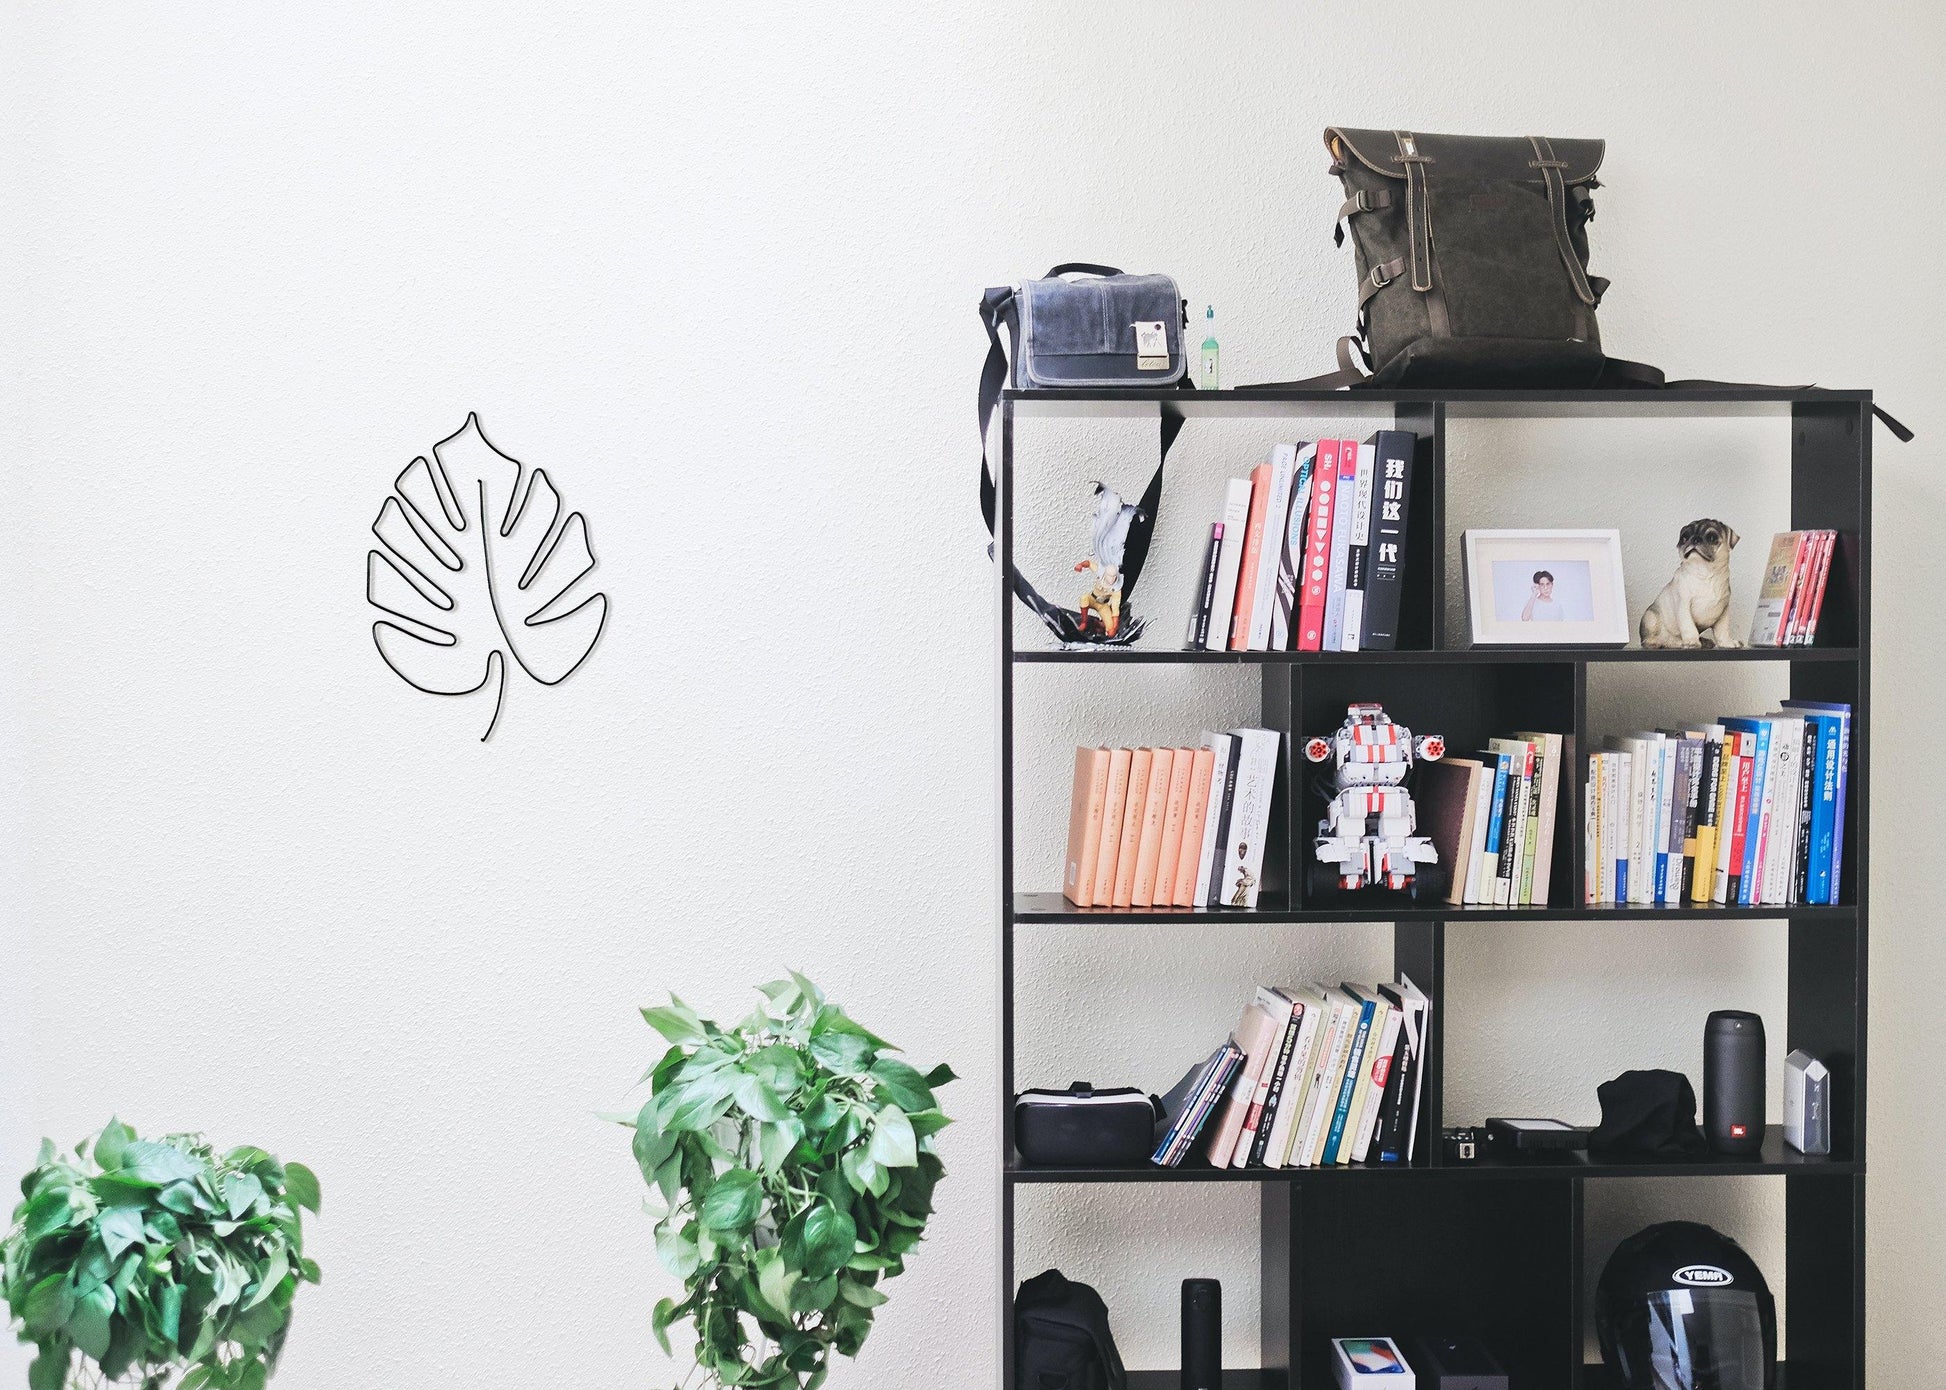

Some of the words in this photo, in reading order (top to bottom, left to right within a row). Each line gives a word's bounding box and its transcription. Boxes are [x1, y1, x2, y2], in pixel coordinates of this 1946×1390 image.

[1289, 497, 1304, 548] ILLUSIONS
[1340, 485, 1354, 525] NAOTO
[1378, 458, 1405, 563] 我们这一代
[1334, 529, 1350, 593] FUKASAWA
[1684, 1270, 1724, 1282] YEMA
